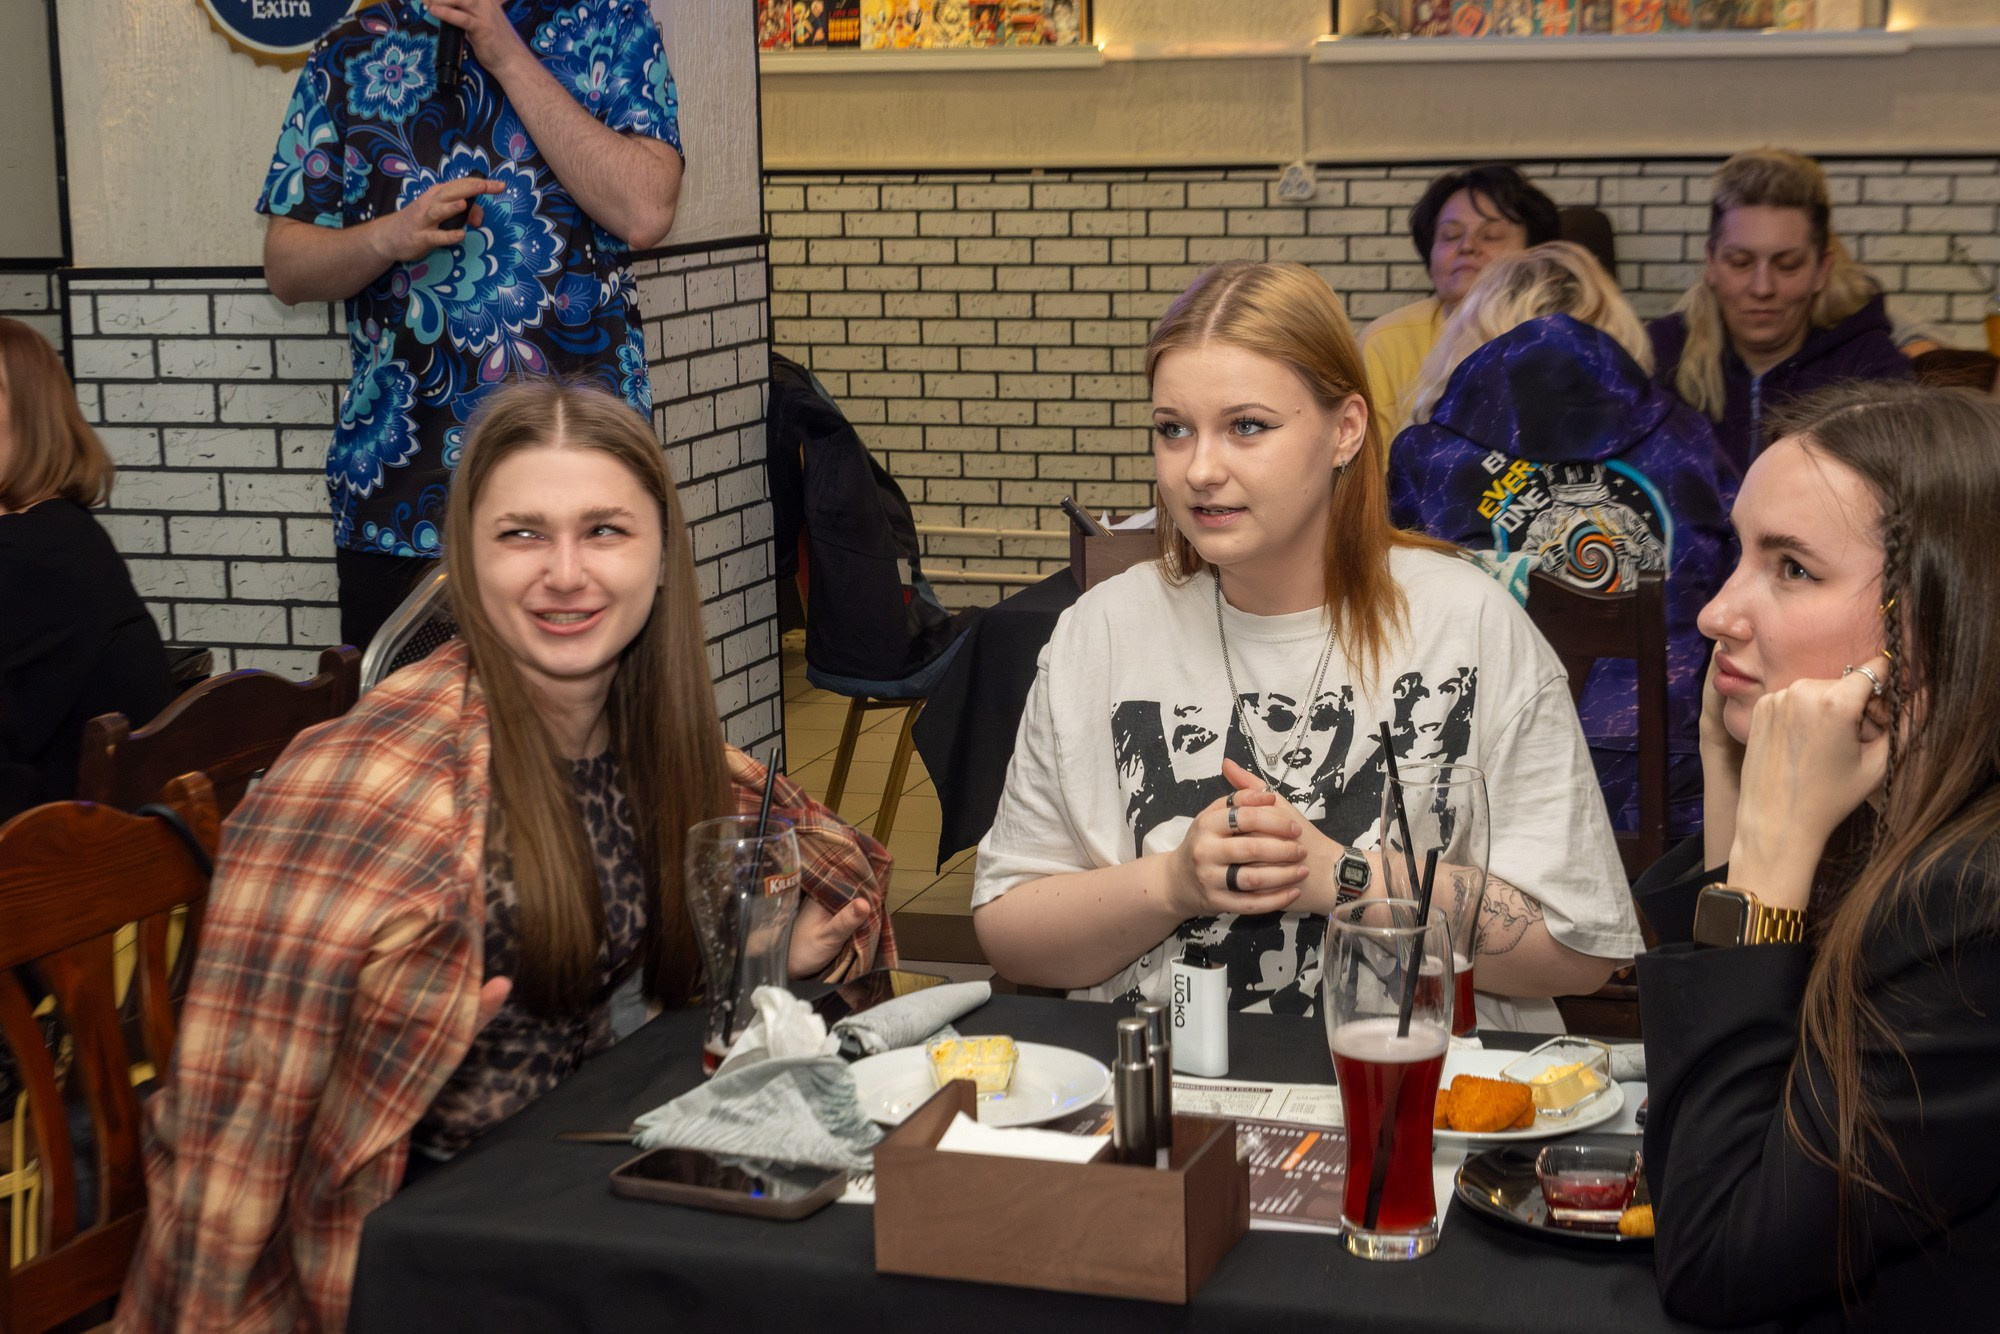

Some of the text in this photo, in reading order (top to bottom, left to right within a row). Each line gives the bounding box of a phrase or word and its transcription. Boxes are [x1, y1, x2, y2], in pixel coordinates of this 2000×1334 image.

[252, 0, 311, 19] Extra
[1477, 459, 1538, 519] EVER
[1495, 487, 1551, 534] ONE
